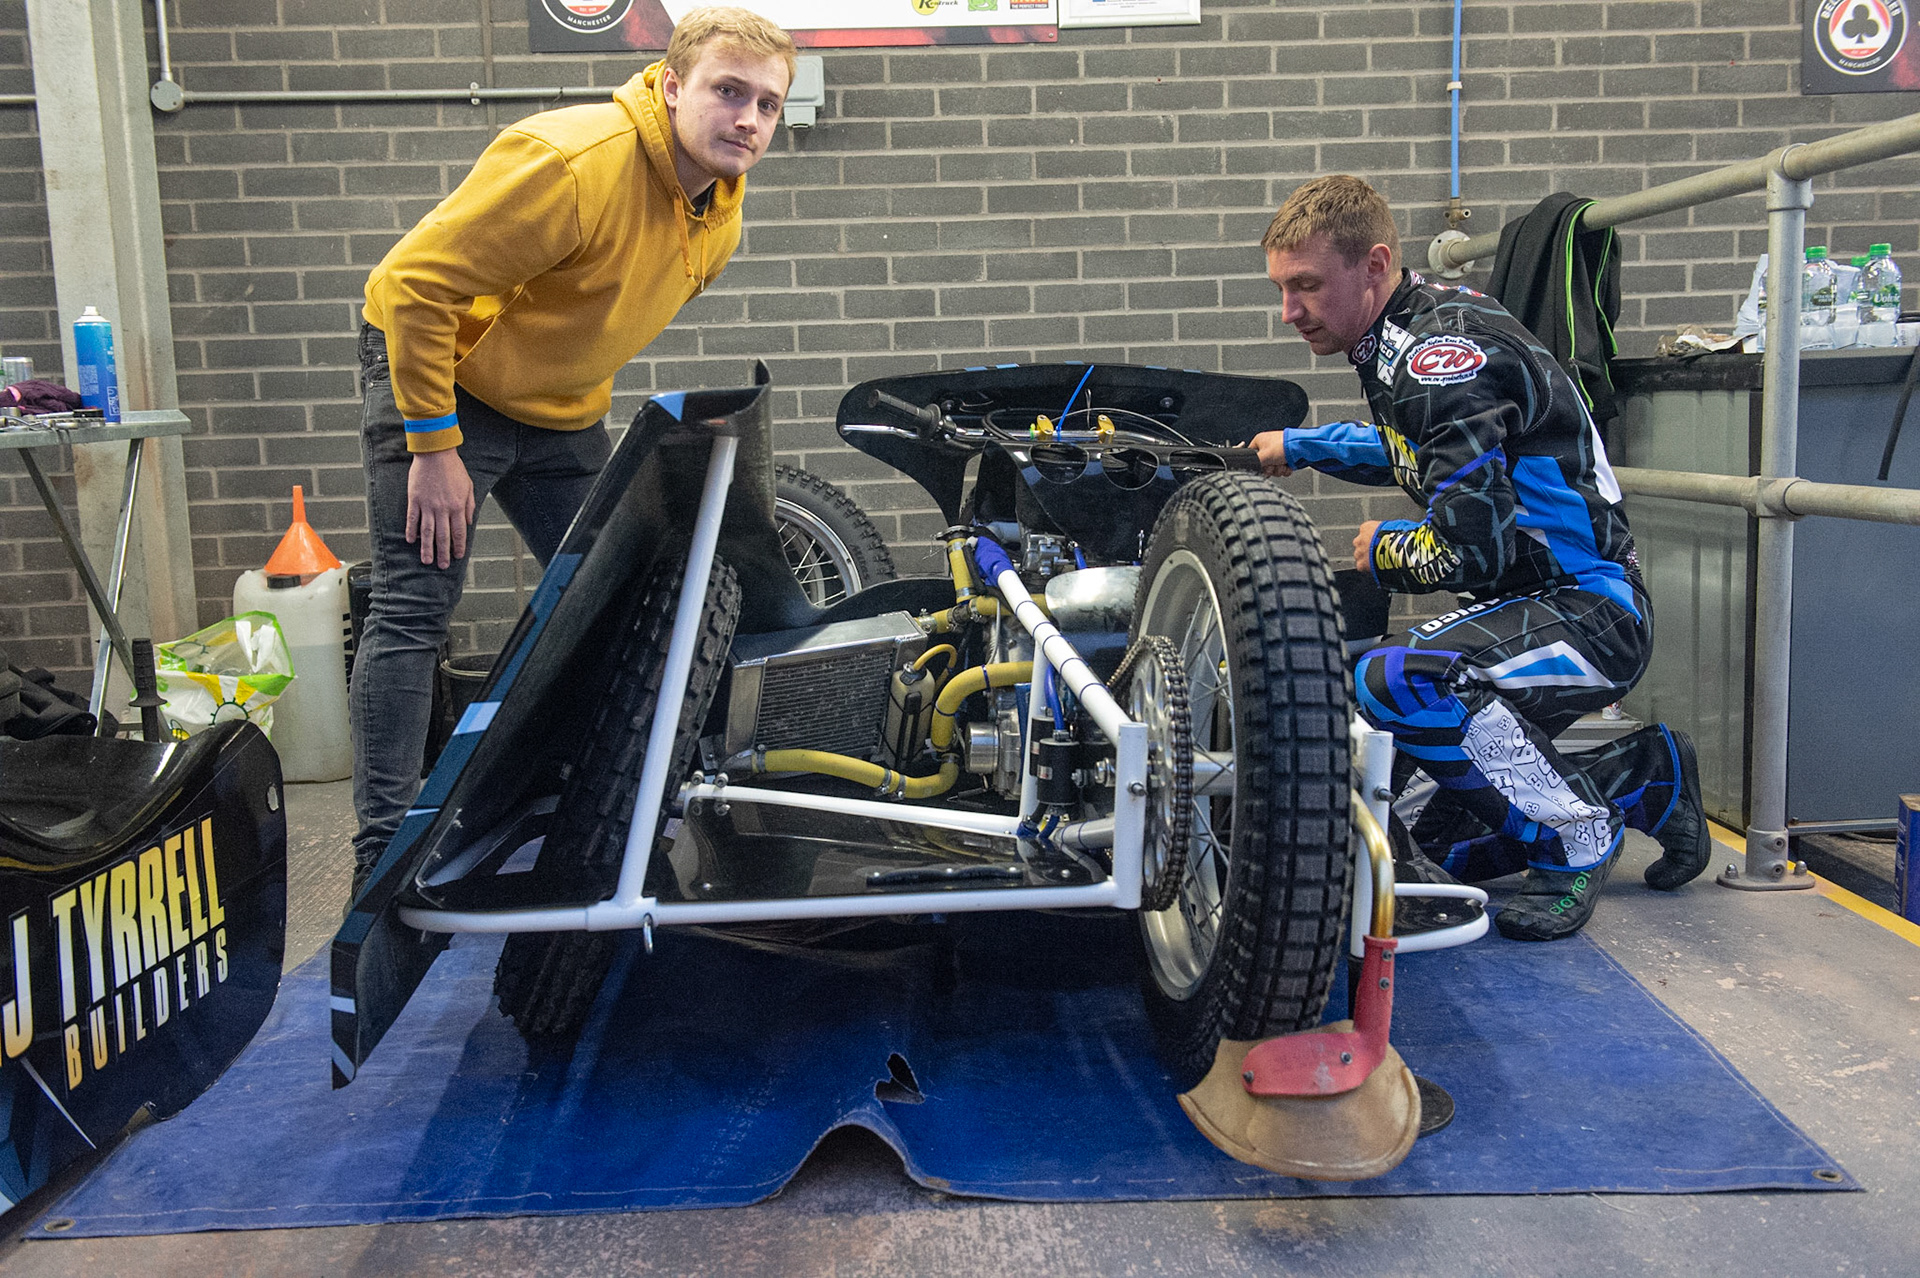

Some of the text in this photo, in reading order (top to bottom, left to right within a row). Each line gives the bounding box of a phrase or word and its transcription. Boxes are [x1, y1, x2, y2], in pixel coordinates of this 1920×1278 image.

[567, 14, 611, 26] MANCHESTER
[52, 817, 226, 1024] TYRRELL
[65, 927, 229, 1091] BUILDERS
